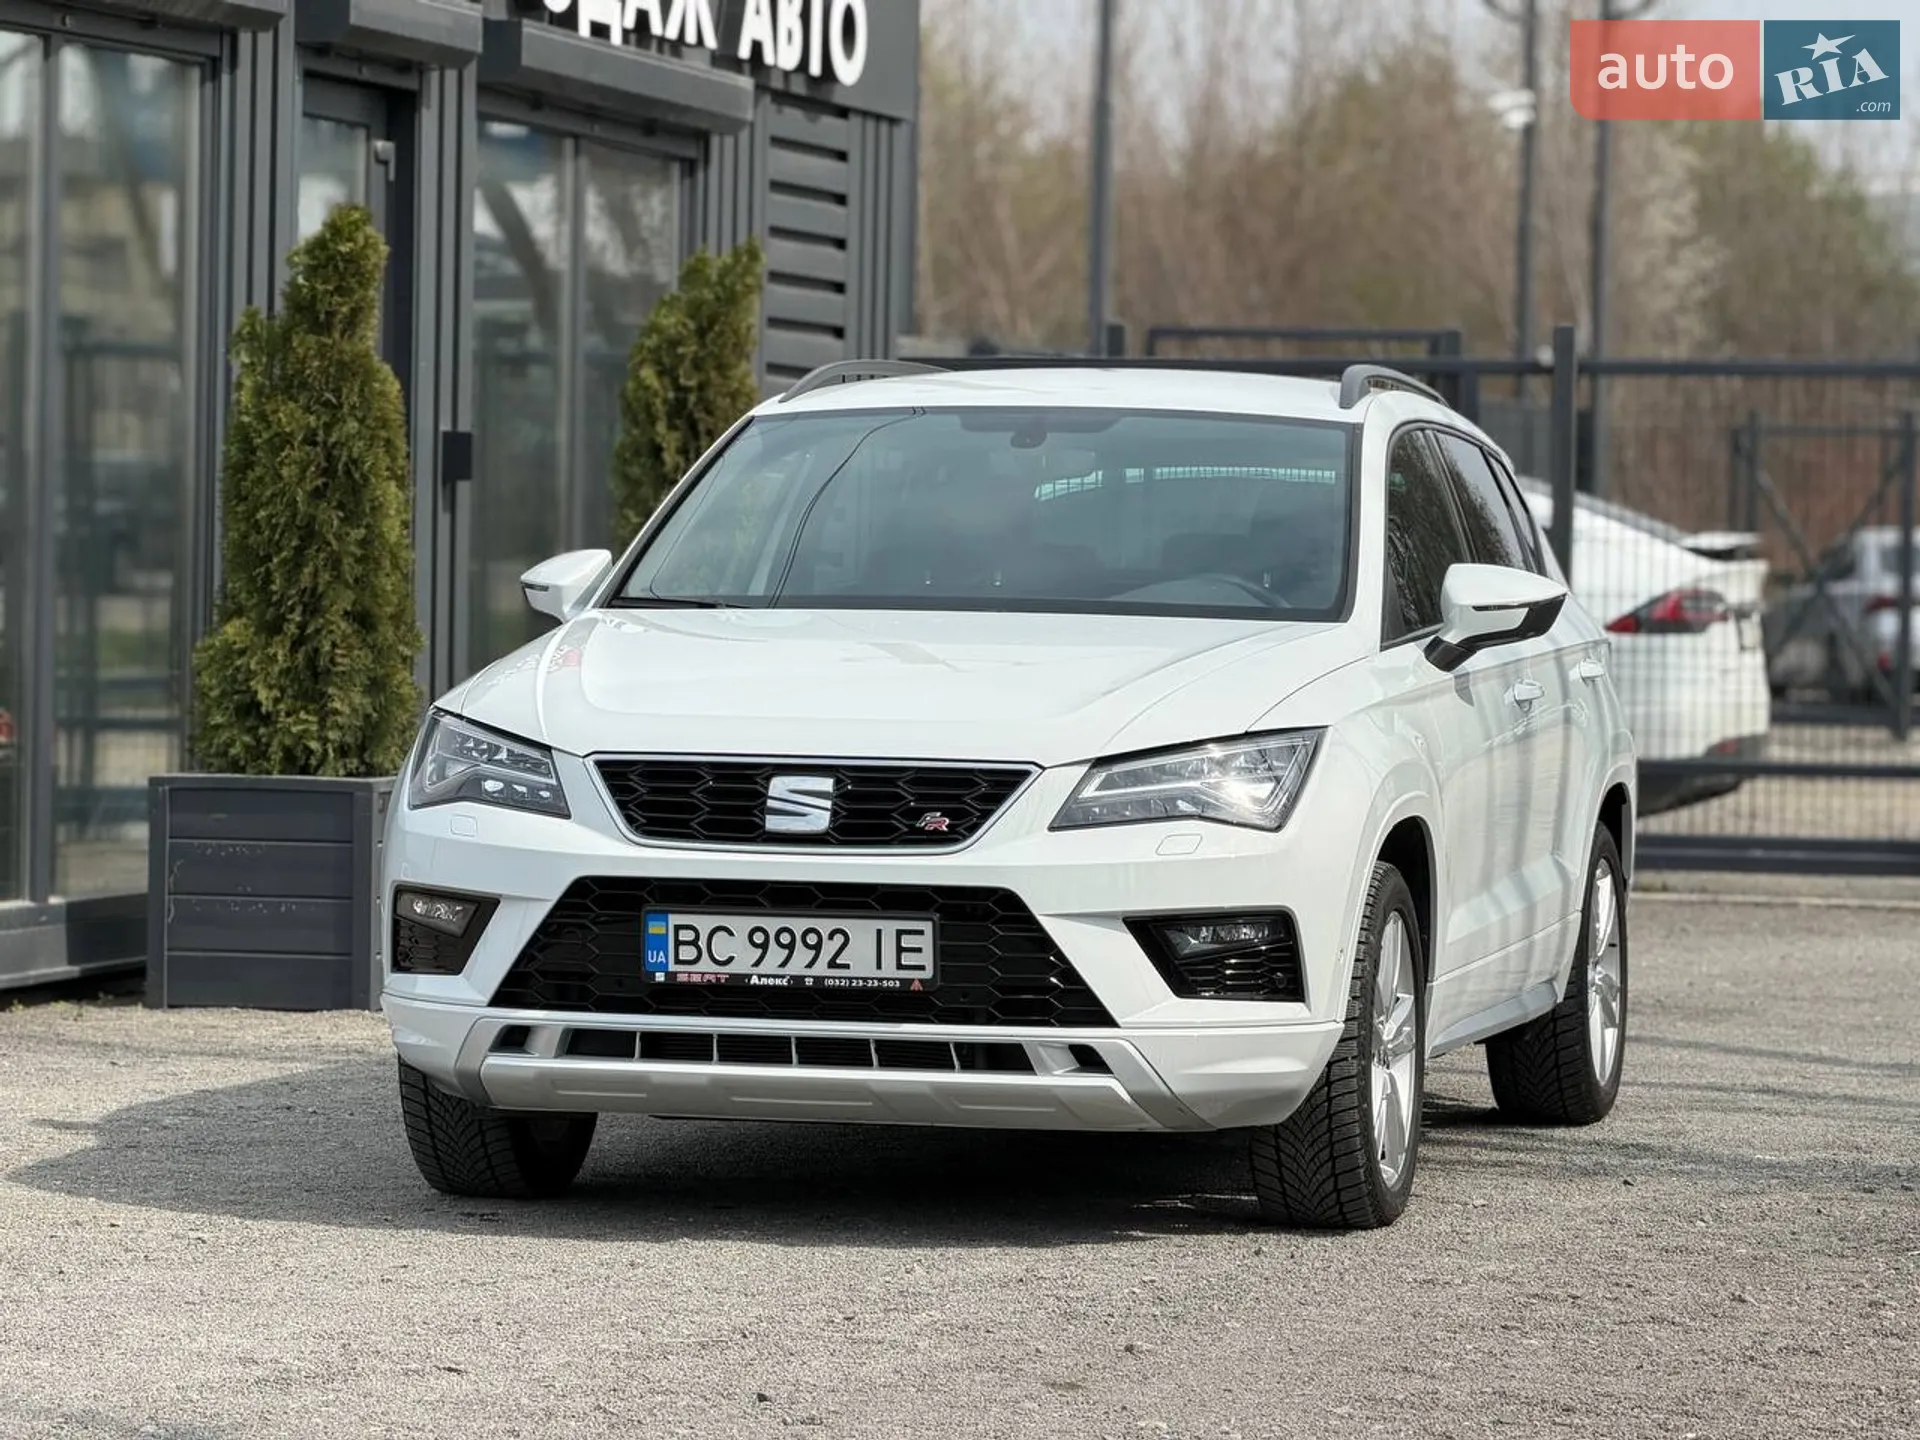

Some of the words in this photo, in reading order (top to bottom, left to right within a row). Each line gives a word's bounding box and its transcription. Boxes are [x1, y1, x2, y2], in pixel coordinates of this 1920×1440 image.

[648, 950, 666, 963] UA
[673, 924, 737, 967] BC
[747, 926, 851, 970] 9992
[875, 928, 927, 971] IE
